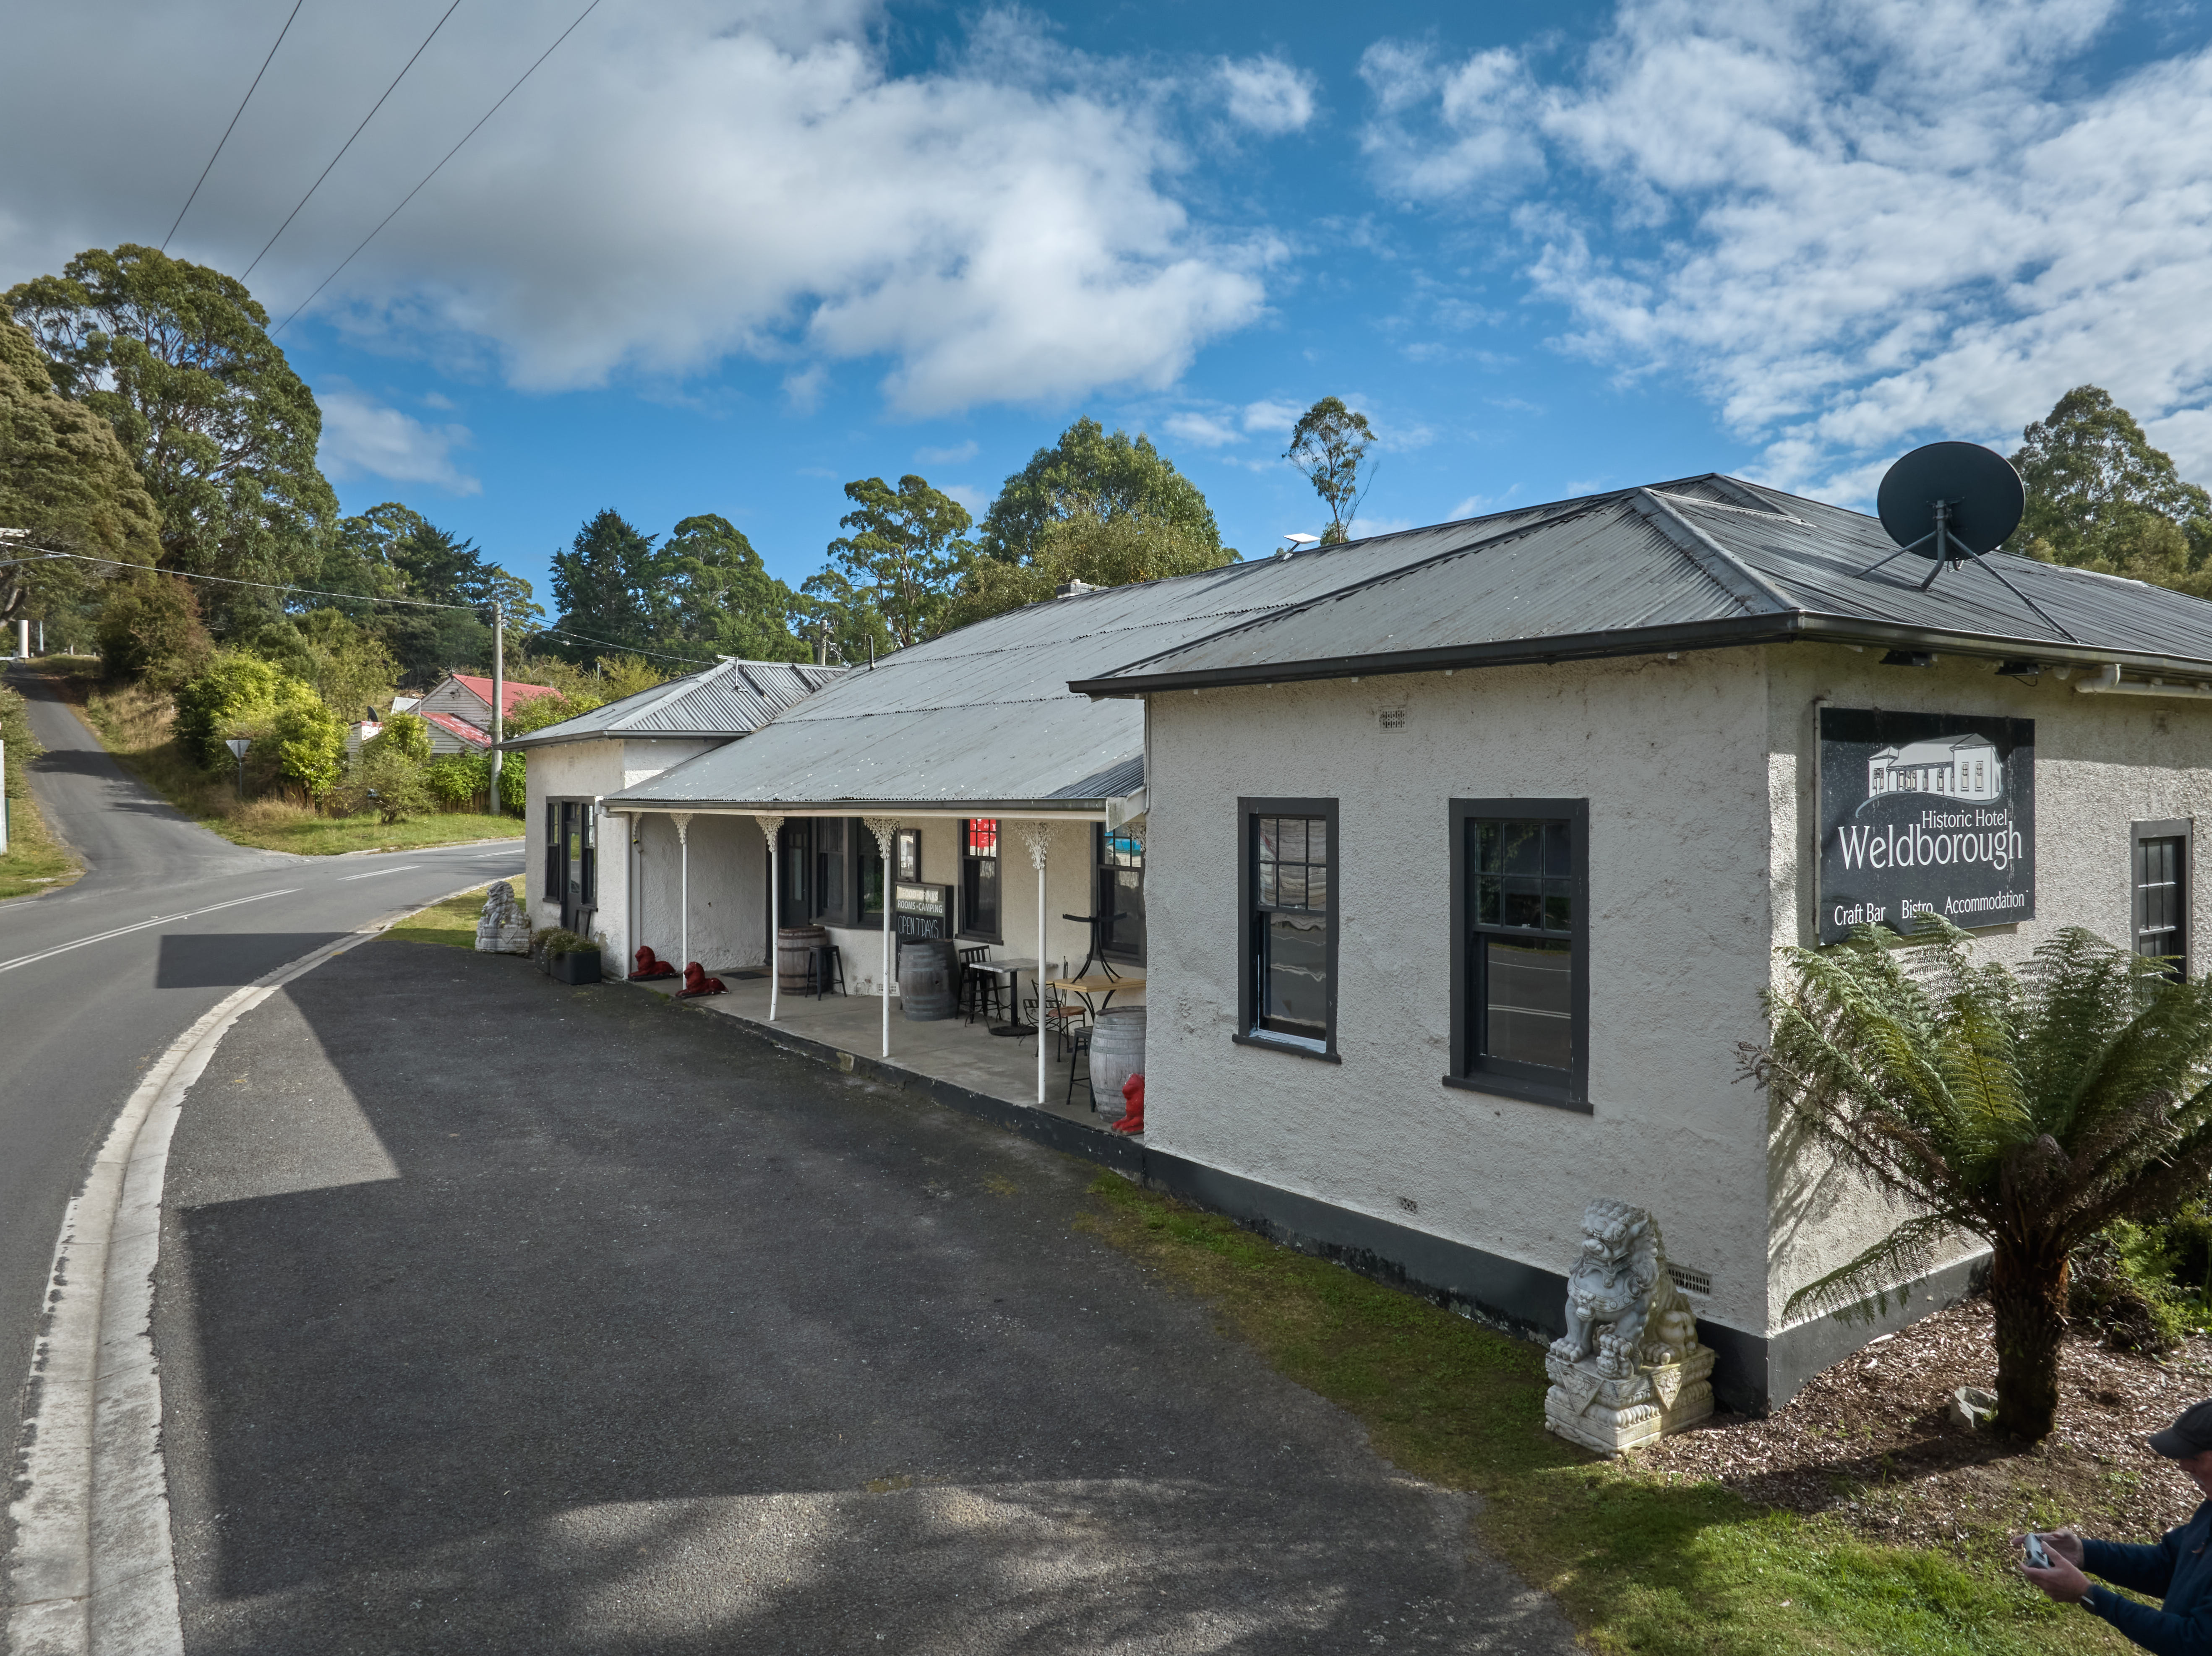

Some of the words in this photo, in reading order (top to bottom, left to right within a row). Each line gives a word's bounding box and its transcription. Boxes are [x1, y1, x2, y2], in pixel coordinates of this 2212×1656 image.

[1922, 810, 1972, 828] Historic
[1975, 808, 2007, 826] Hotel
[1837, 820, 2023, 870] Weldborough
[898, 900, 916, 910] ROOMS
[918, 903, 943, 913] CAMPING
[903, 890, 916, 898] FOOD
[919, 890, 938, 901] DRINKS
[1834, 904, 1863, 926] Craft
[1867, 903, 1886, 922] Bar
[1901, 899, 1933, 919] Bistro
[1944, 890, 2024, 914] Accommodation
[898, 915, 915, 935] OPEN
[916, 918, 920, 936] 7
[921, 919, 939, 939] DAYS
